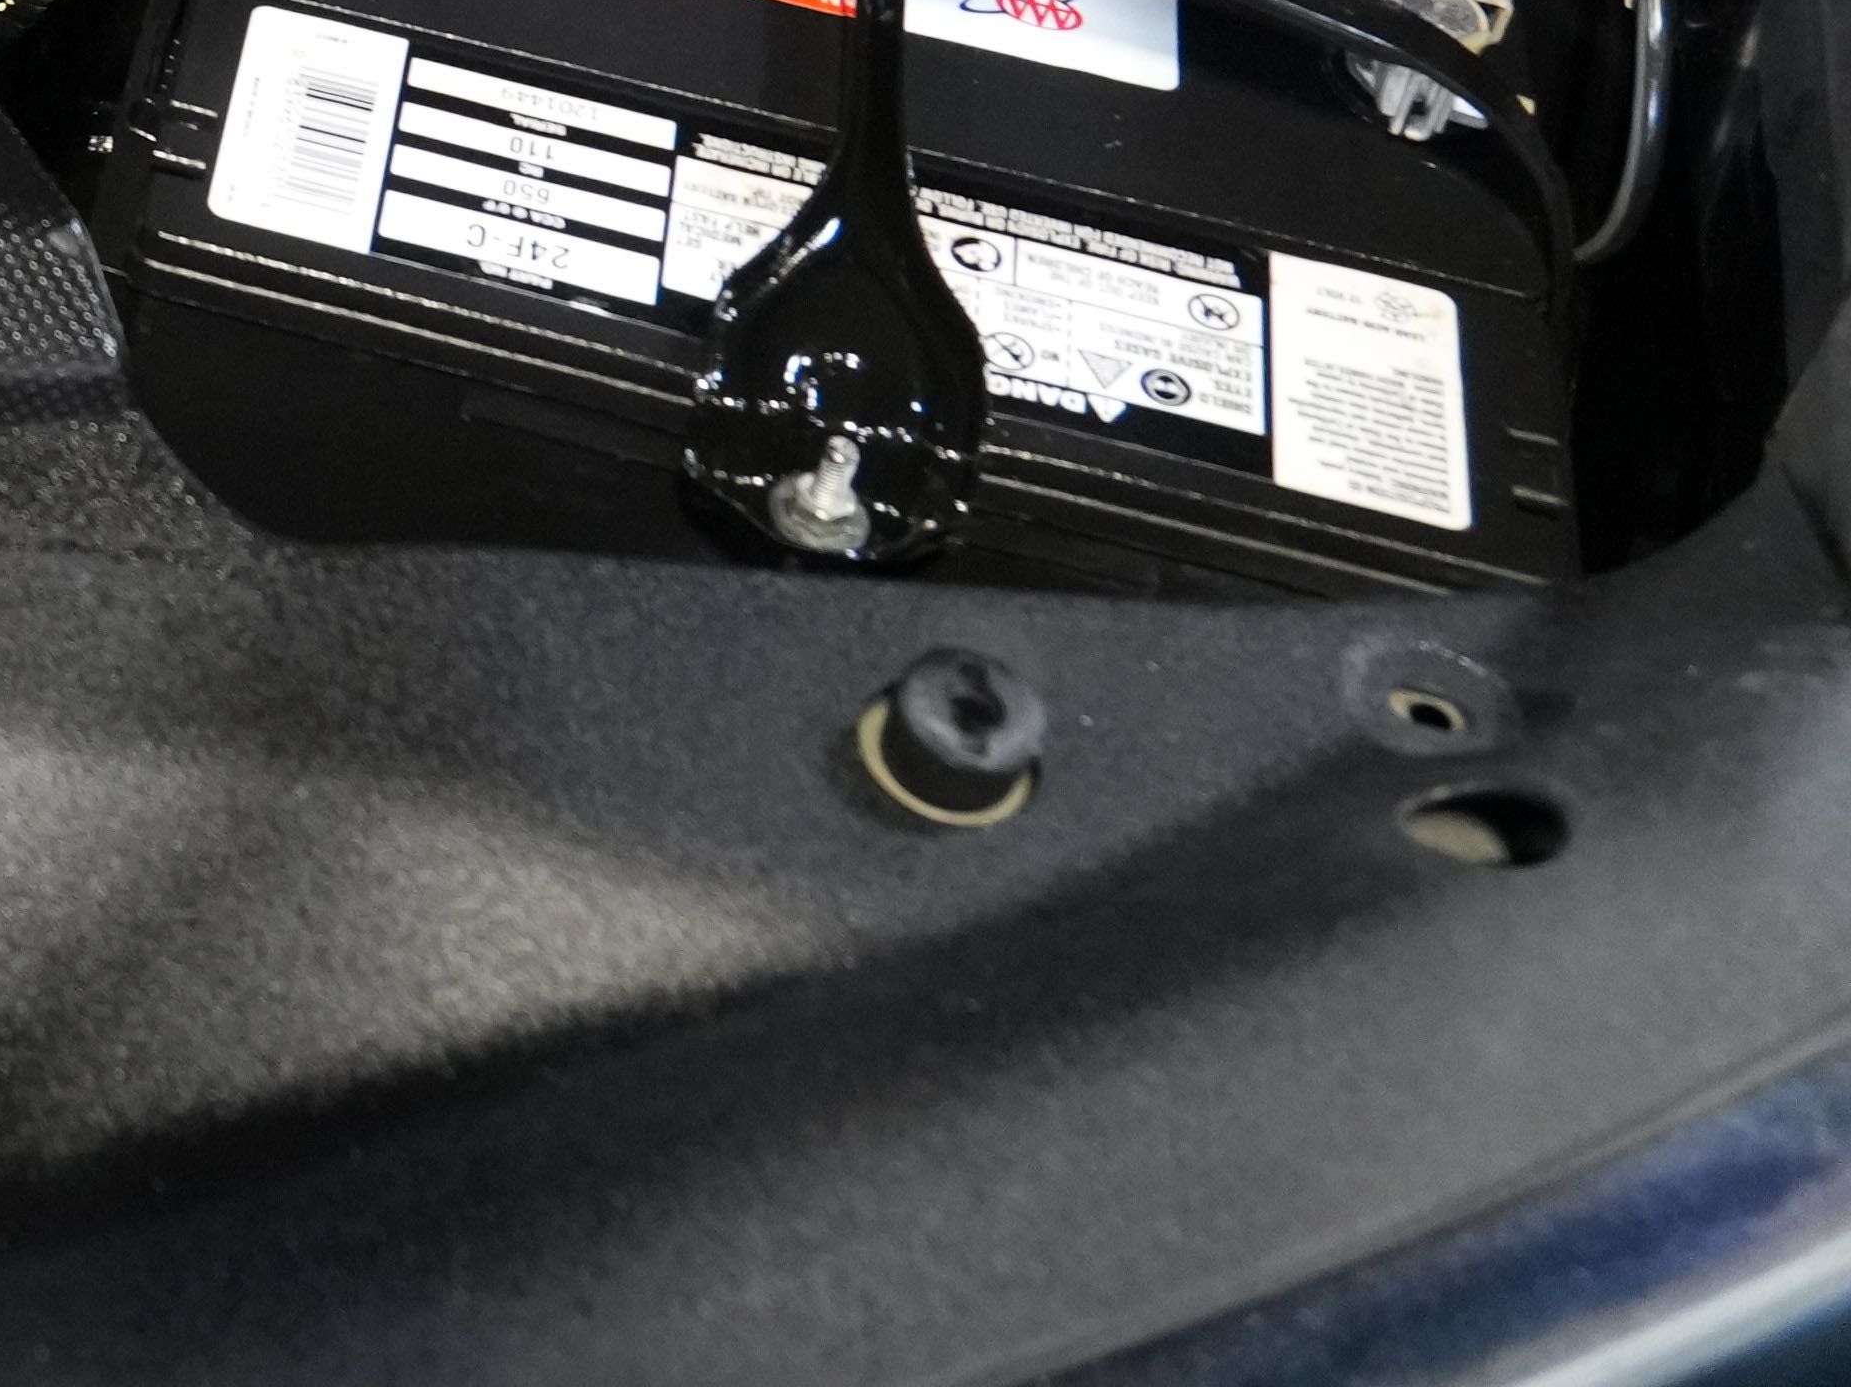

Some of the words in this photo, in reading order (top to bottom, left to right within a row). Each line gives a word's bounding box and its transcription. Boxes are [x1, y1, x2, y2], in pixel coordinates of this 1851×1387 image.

[501, 85, 600, 121] 1201449
[508, 135, 554, 161] 110
[503, 178, 550, 206] 650
[465, 222, 571, 271] 24F-C
